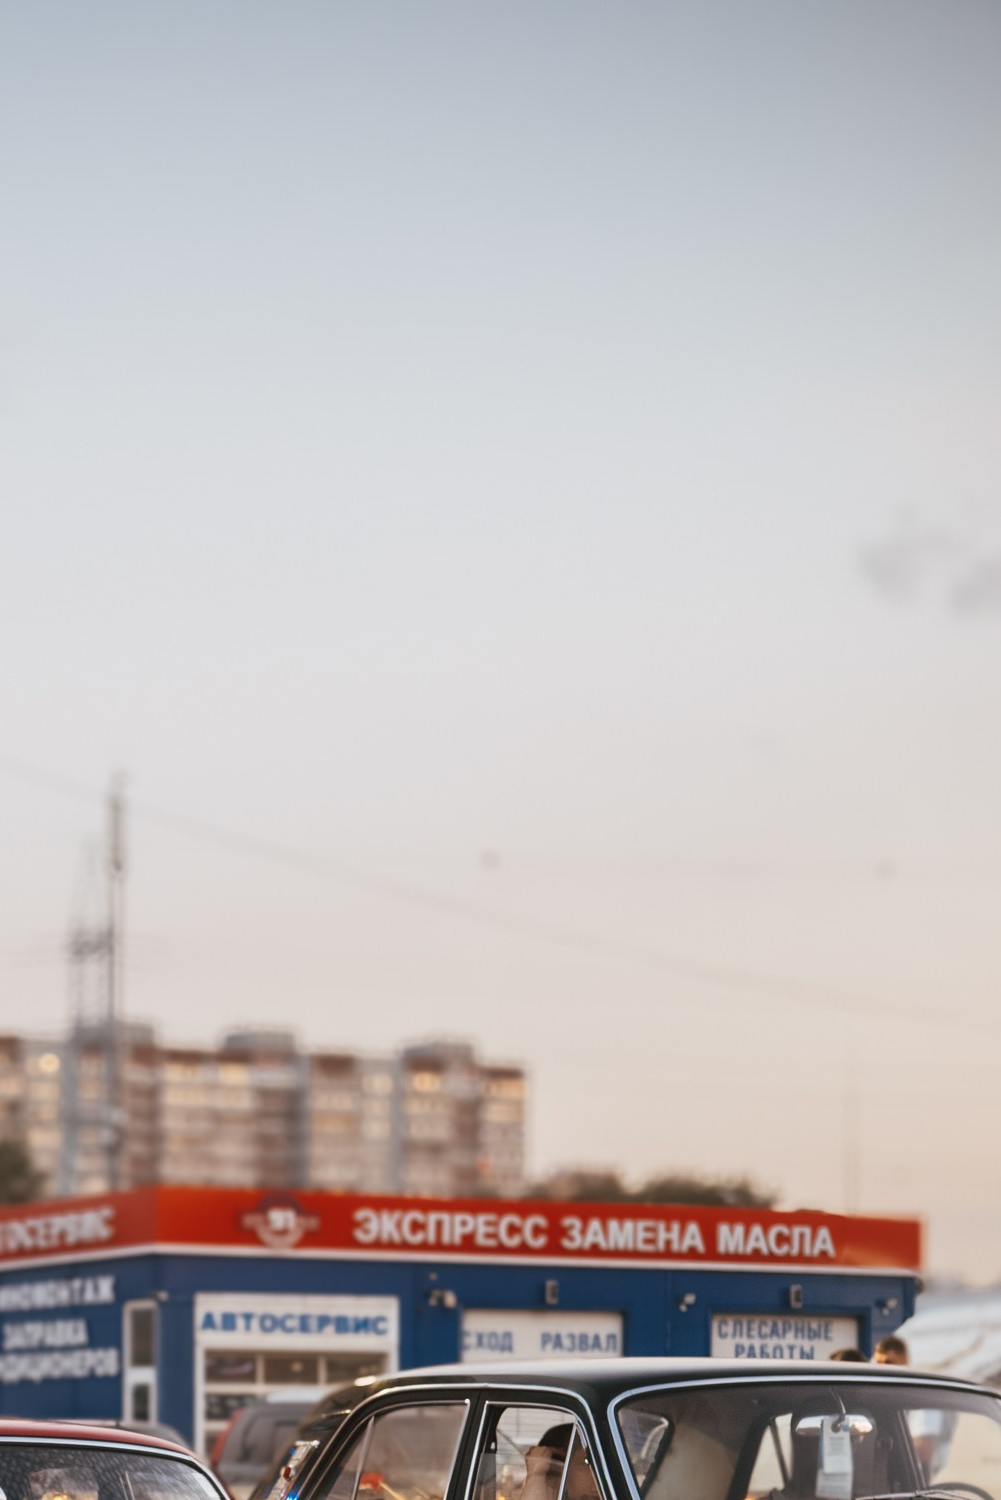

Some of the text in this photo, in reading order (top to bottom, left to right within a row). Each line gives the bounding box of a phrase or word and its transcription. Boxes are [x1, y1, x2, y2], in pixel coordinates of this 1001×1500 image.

[353, 1208, 548, 1249] ЭКСПРЕСС
[561, 1215, 704, 1253] ЗАМЕНА
[717, 1223, 836, 1258] МАСЛА
[201, 1312, 388, 1335] АВТОСЕРВИС
[717, 1317, 833, 1342] СЛЕСАРНЫЕ
[541, 1331, 618, 1353] РАЗВАЛ
[734, 1343, 815, 1360] РАБОТЫ
